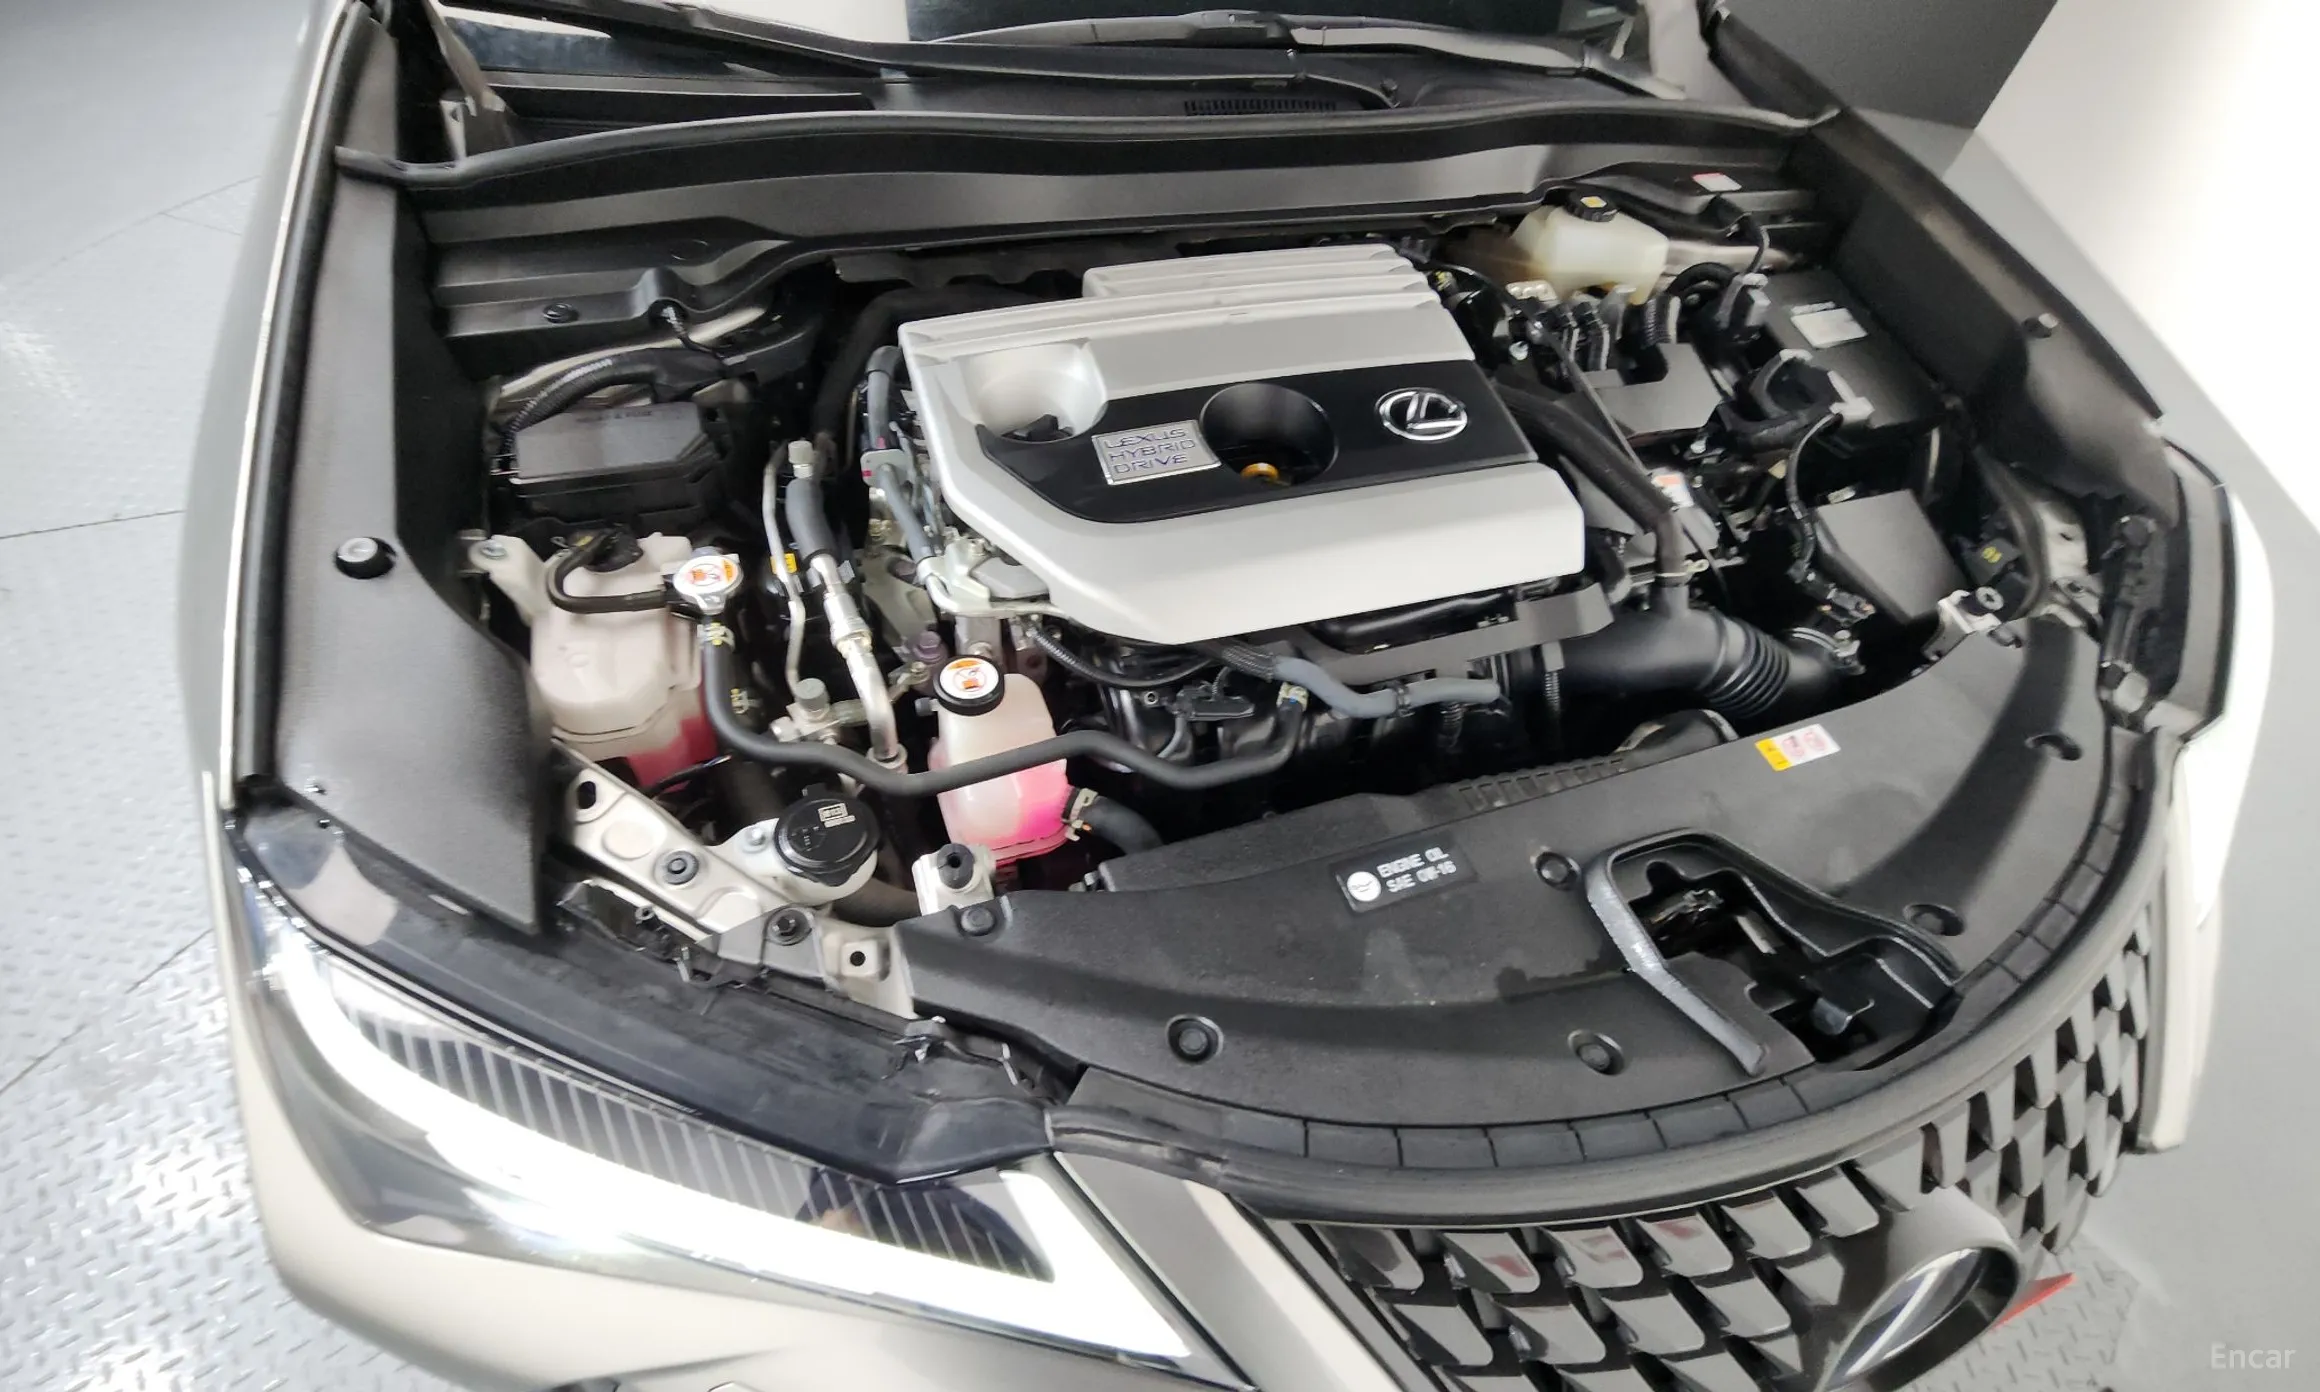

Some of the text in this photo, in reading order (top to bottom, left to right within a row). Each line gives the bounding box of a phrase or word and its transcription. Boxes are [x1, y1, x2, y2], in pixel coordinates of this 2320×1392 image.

[1104, 428, 1186, 449] LEXUS
[1108, 439, 1196, 461] HYBRID
[1114, 454, 1188, 474] DRIVE
